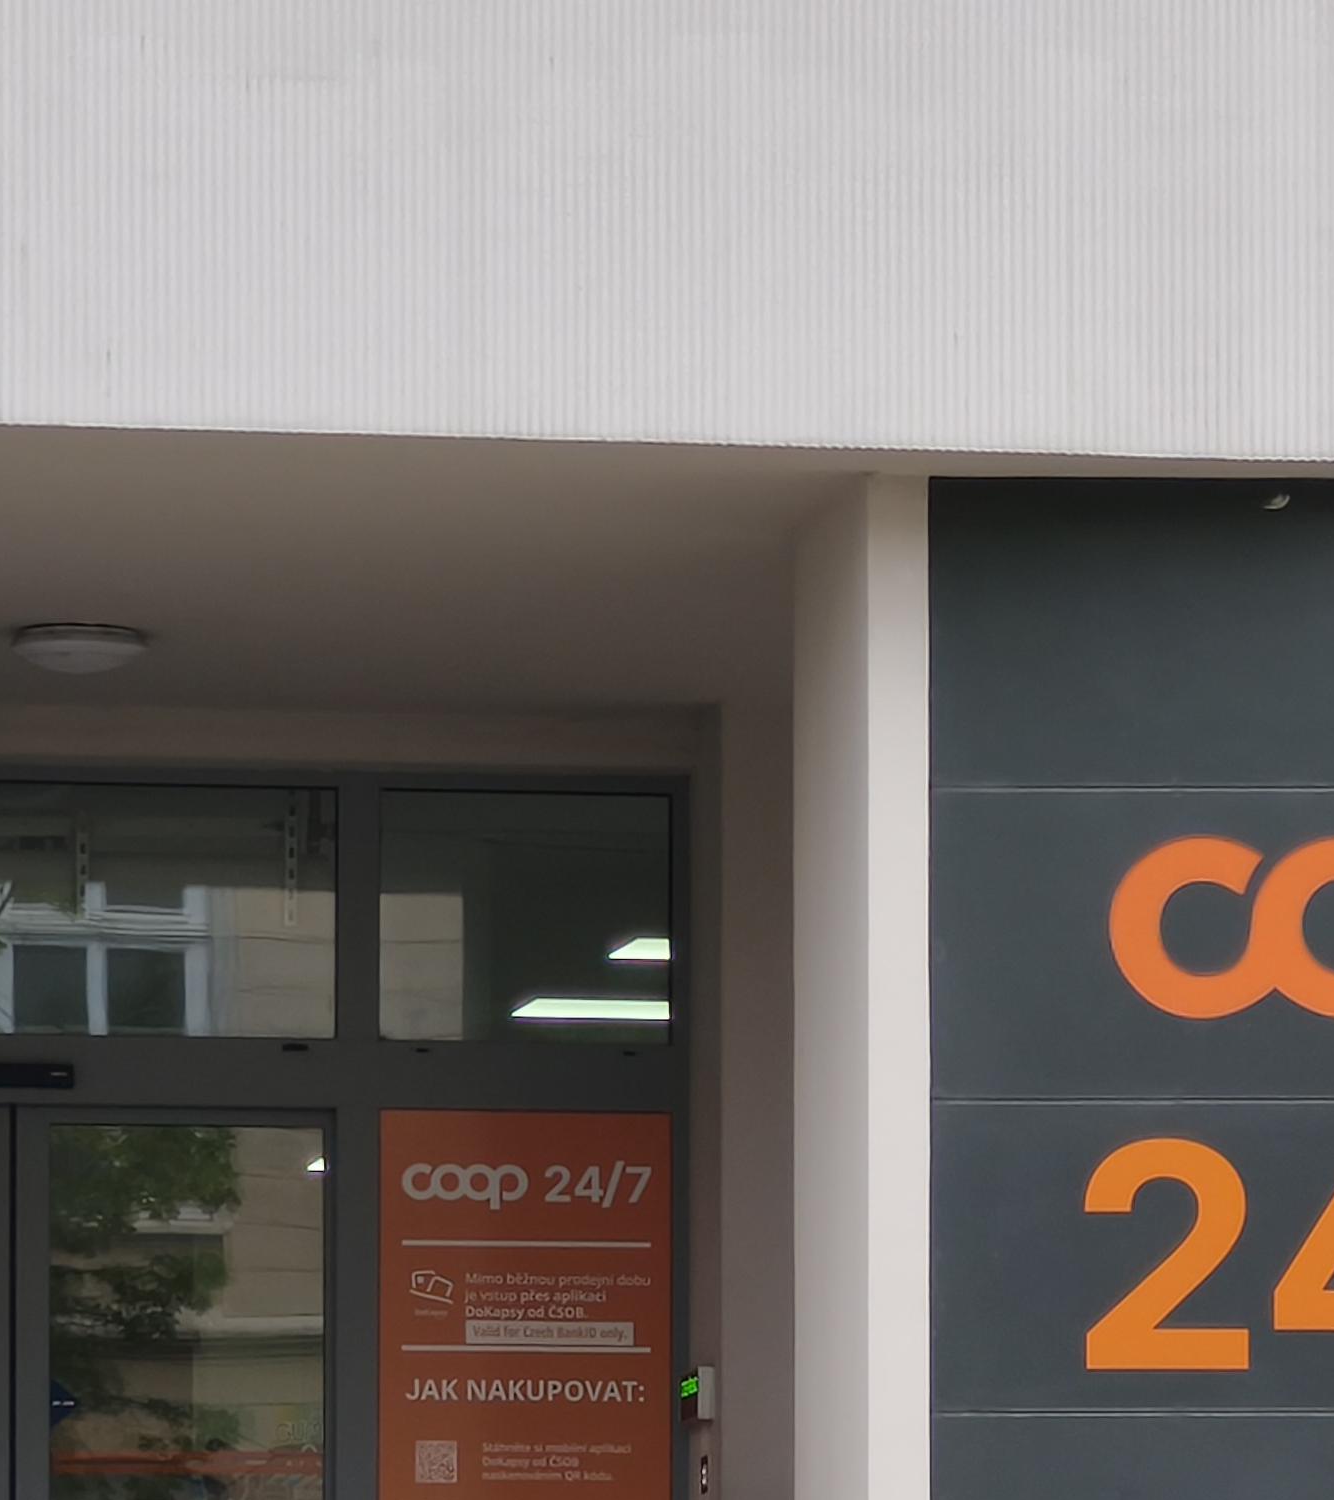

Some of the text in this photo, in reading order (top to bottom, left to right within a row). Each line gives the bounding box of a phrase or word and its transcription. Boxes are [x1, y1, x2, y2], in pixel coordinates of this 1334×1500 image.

[402, 1161, 651, 1210] coop 24/7
[466, 1273, 503, 1286] Mimo
[617, 1274, 651, 1287] dobu
[520, 1289, 550, 1304] přes
[466, 1306, 525, 1320] DoKapsy
[528, 1307, 545, 1319] od
[473, 1326, 500, 1338] Valid
[503, 1326, 519, 1338] for
[523, 1326, 553, 1338] Czech
[405, 1379, 645, 1402] JAK NAKUPOVAT:
